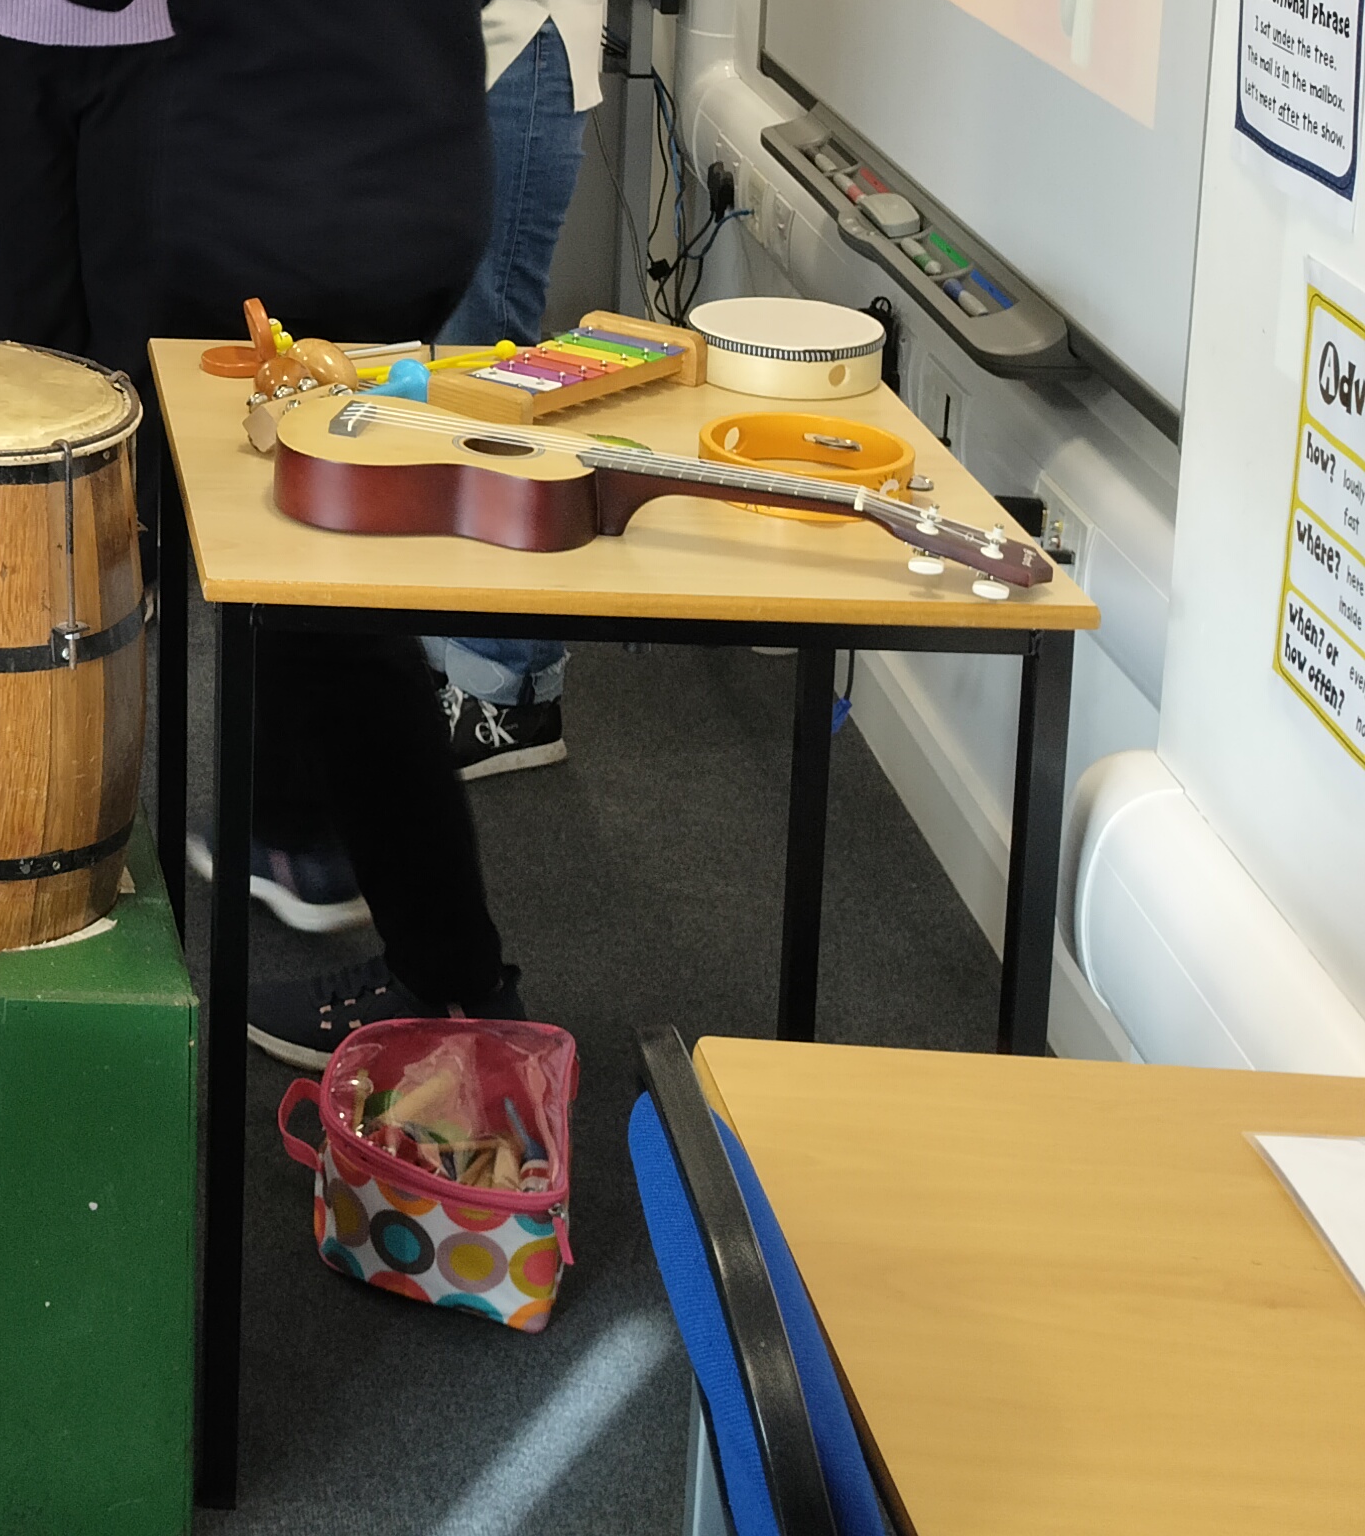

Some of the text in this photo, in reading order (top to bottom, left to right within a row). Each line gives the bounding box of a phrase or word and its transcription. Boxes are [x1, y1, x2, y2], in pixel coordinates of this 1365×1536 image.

[1254, 15, 1338, 71] I sat under the tree.
[1312, 2, 1350, 39] phrase
[1247, 44, 1346, 113] The mail is in the mailbox.
[1244, 76, 1346, 150] Let's meet after the show.
[1305, 431, 1336, 484] how?
[1343, 507, 1360, 535] fast
[1296, 519, 1364, 596] where? here
[1288, 602, 1339, 667] when? or
[1339, 595, 1363, 631] inside
[1285, 631, 1346, 716] how often?
